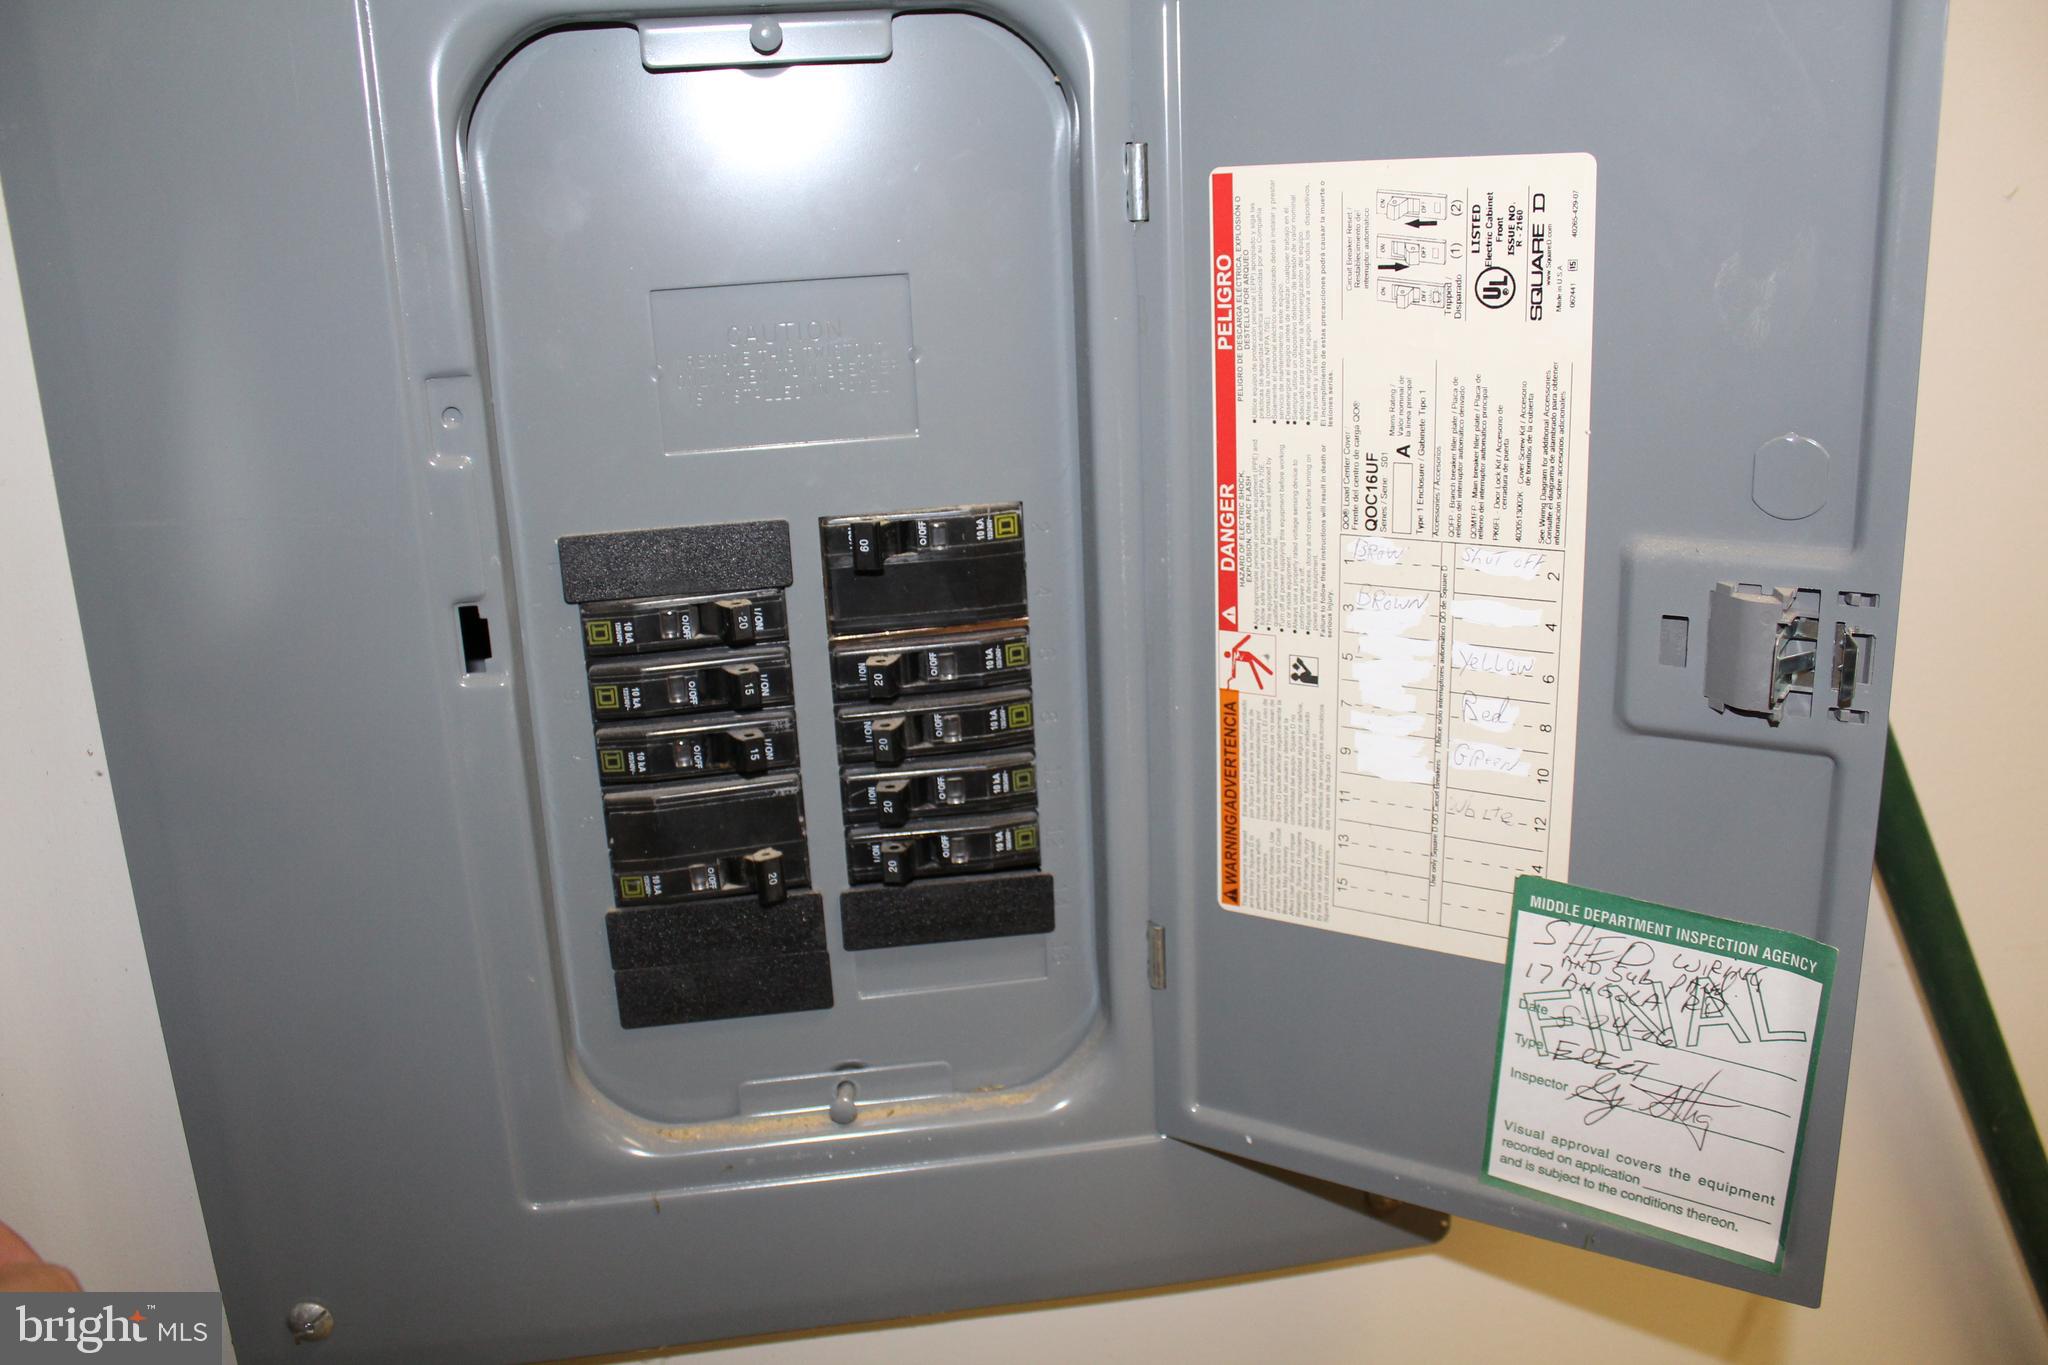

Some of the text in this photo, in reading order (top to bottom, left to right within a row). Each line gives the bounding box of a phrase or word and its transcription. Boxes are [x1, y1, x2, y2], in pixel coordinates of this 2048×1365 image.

[1450, 200, 1463, 216] (2)
[1471, 204, 1481, 253] LISTED
[1485, 192, 1494, 267] Electric Cabinet
[1508, 202, 1516, 256] ISSUE NO.
[1450, 243, 1463, 259] (1)
[1531, 193, 1545, 321] SQUARE D
[1569, 261, 1576, 269] 15
[1235, 255, 1243, 303] ELÉCTRICA,
[1216, 255, 1233, 349] PELIGRO
[1454, 274, 1463, 319] Disparado
[1237, 353, 1243, 364] DE
[1418, 397, 1427, 415] Tipo
[1397, 445, 1411, 458] A
[1365, 452, 1378, 531] QOC16UF
[1417, 463, 1425, 505] Enclosure
[1220, 484, 1235, 571] DANGER
[1246, 522, 1252, 534] OR
[1417, 514, 1426, 534] Type
[860, 539, 869, 552] 60
[1239, 543, 1244, 553] OF
[1548, 572, 1560, 581] 2
[738, 616, 748, 629] 20
[1546, 623, 1556, 631] 4
[1342, 653, 1353, 661] 5
[874, 673, 883, 686] 20
[1543, 675, 1554, 683] 6
[745, 683, 754, 695] 15
[1462, 691, 1509, 723] Red
[879, 738, 888, 751] 20
[1341, 747, 1351, 755] 9
[750, 748, 759, 761] 15
[1537, 769, 1549, 784] 10
[1223, 701, 1238, 884] WARNING/ADVERTENCIA
[1340, 790, 1350, 803] 11
[884, 801, 893, 813] 20
[1535, 817, 1546, 832] 12
[1339, 834, 1349, 848] 13
[888, 860, 897, 872] 20
[768, 873, 778, 885] 20
[1337, 878, 1348, 892] 15
[1530, 895, 1818, 973] MIDDLE DEPARTMENT INSPECTION AGENCY
[1533, 920, 1655, 967] SHED
[1562, 956, 1600, 976] AND
[1518, 999, 1548, 1015] Date
[1523, 973, 1807, 1056] FINAL
[1514, 1032, 1544, 1051] Type
[1510, 1067, 1568, 1091] Inspector
[1502, 1137, 1641, 1185] recorded on application
[1505, 1120, 1776, 1207] Visual approval covers the equipment
[1499, 1153, 1738, 1232] and is subject to the conditions thereon.
